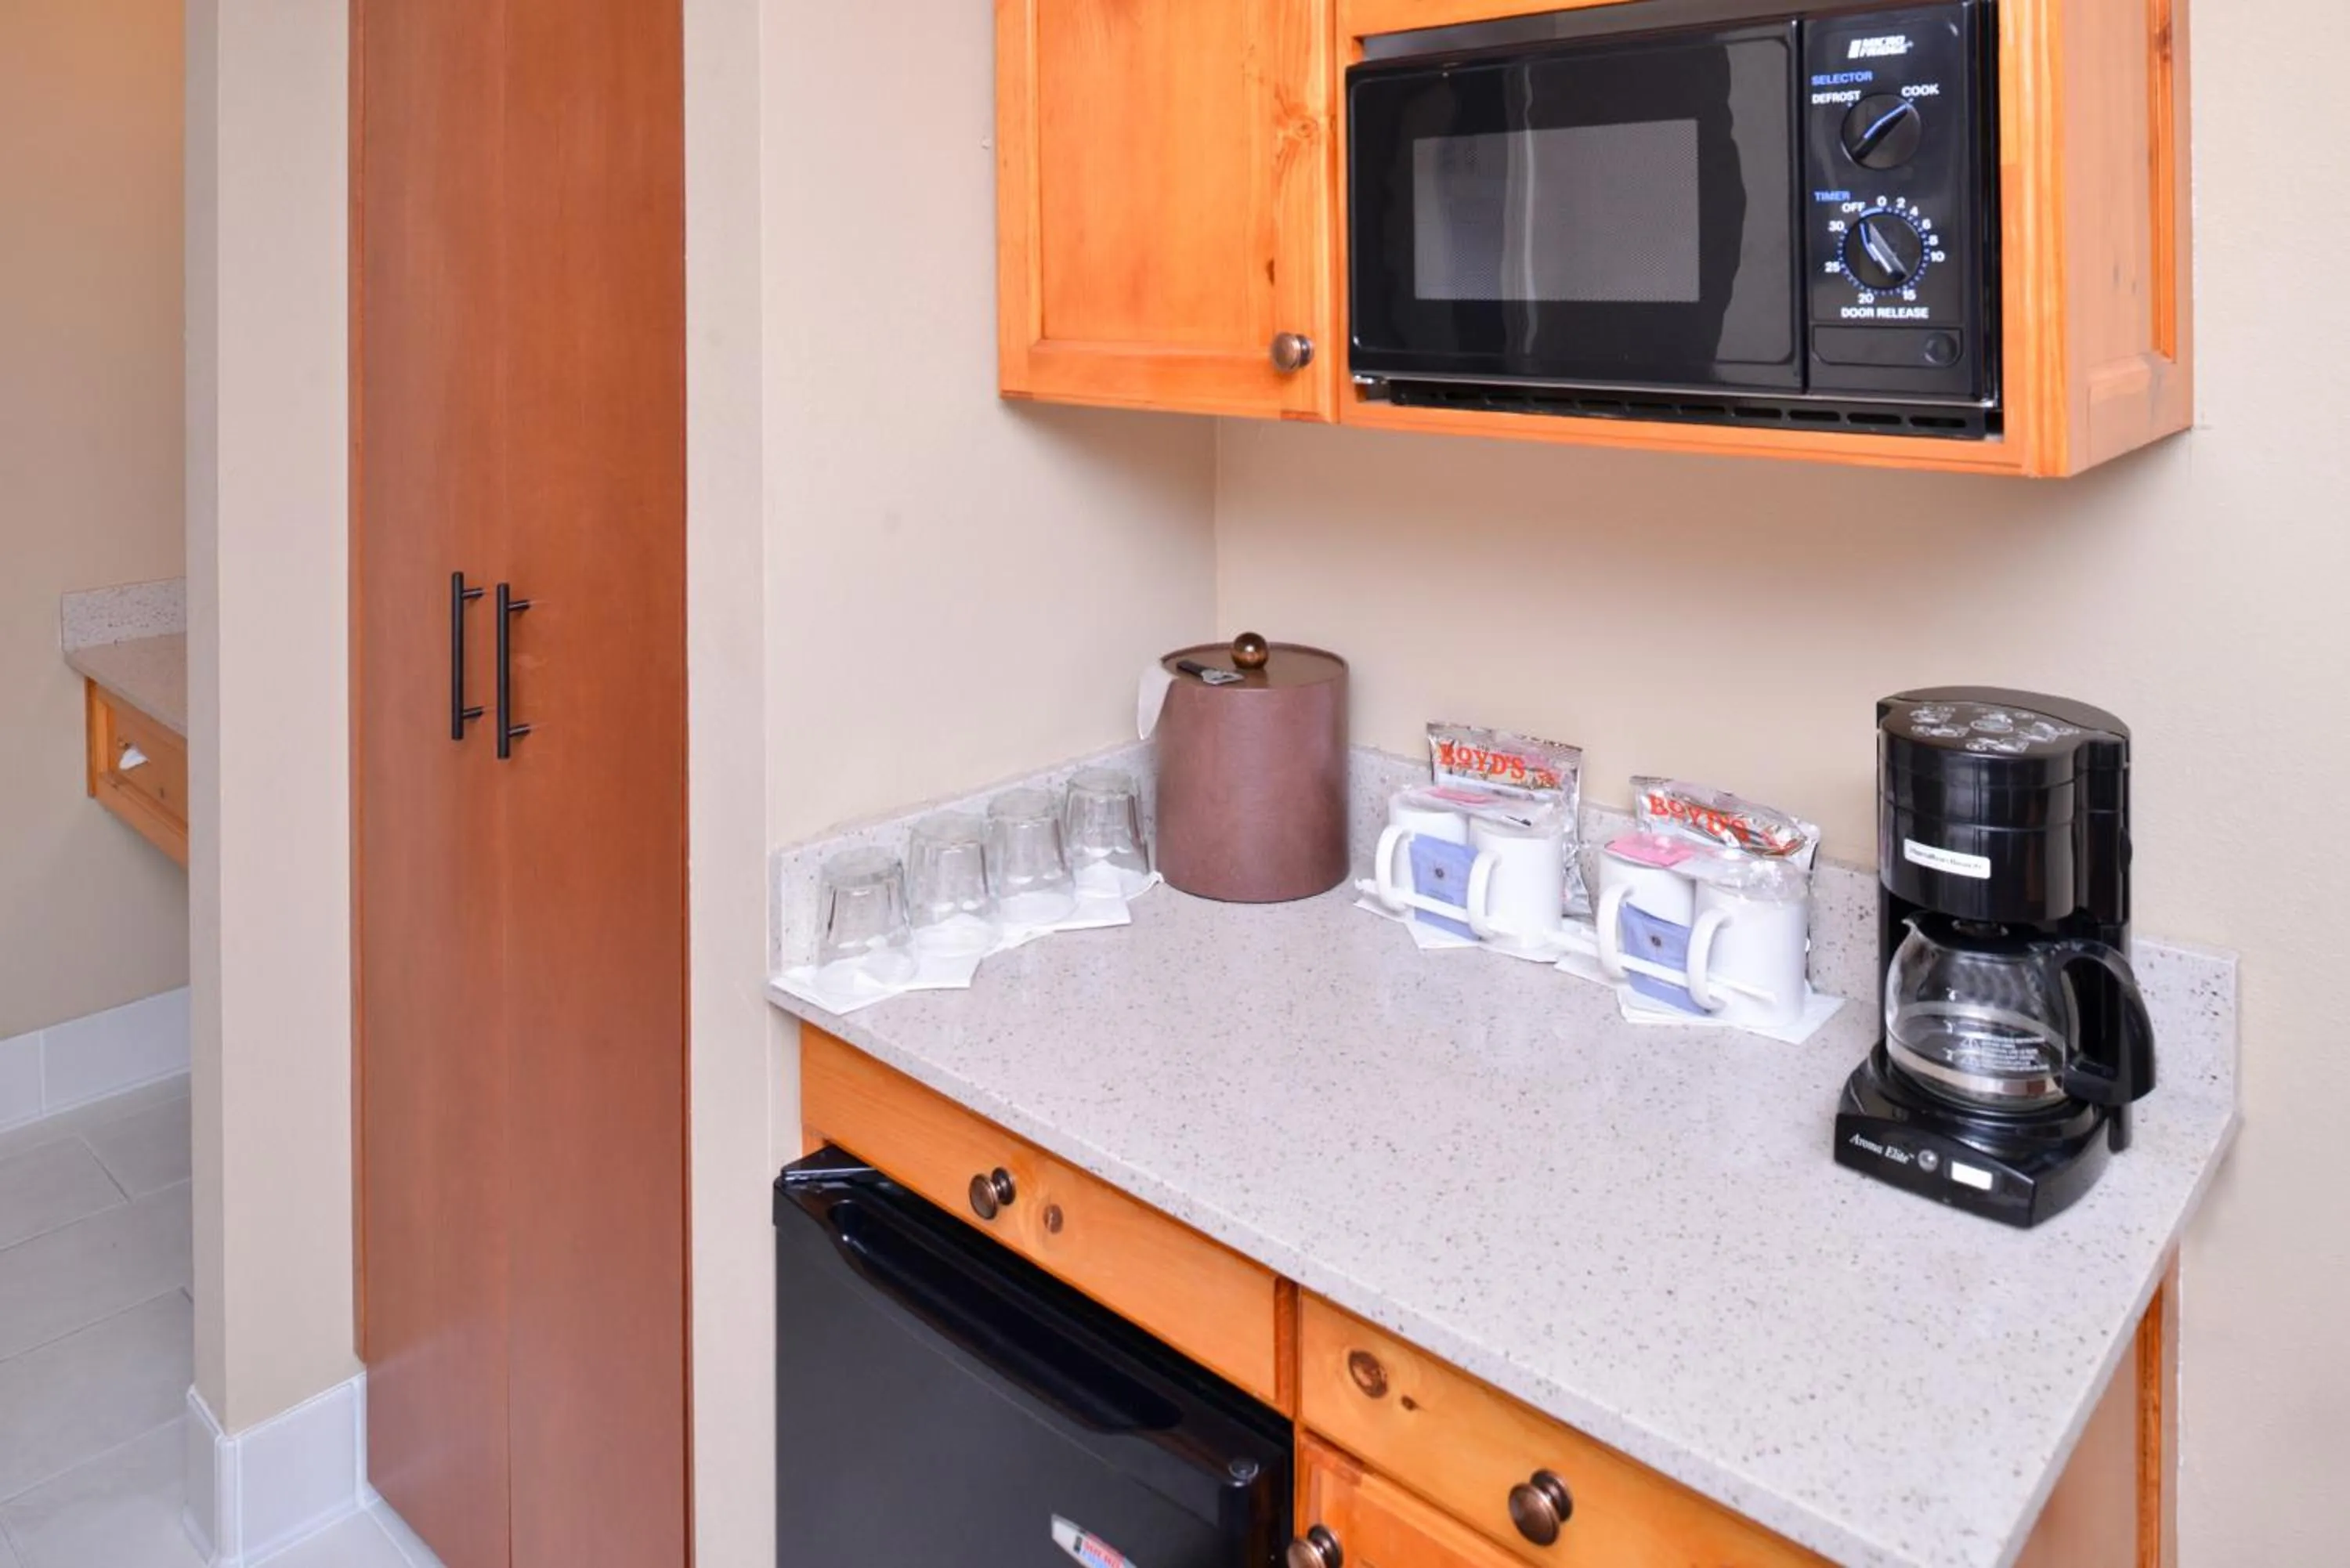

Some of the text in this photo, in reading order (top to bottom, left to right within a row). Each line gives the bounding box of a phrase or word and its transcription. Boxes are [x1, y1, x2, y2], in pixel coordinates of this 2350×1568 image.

[1811, 70, 1873, 85] SELECTOR
[1901, 84, 1940, 97] COOK
[1812, 90, 1861, 104] DEFROST
[1814, 190, 1851, 202] TIMER
[1876, 196, 1887, 207] 0
[1842, 201, 1865, 212] OFF
[1896, 197, 1906, 208] 2
[1910, 206, 1918, 217] 4
[1828, 220, 1845, 232] 30
[1922, 219, 1931, 229] 6
[1931, 251, 1945, 262] 10
[1824, 262, 1840, 273] 25
[1857, 293, 1875, 304] 20
[1903, 290, 1916, 301] 15
[1841, 307, 1929, 319] DOOR RELEASE
[1439, 740, 1526, 780] BOYD'S
[1849, 1133, 1909, 1165] Aroma Elite
